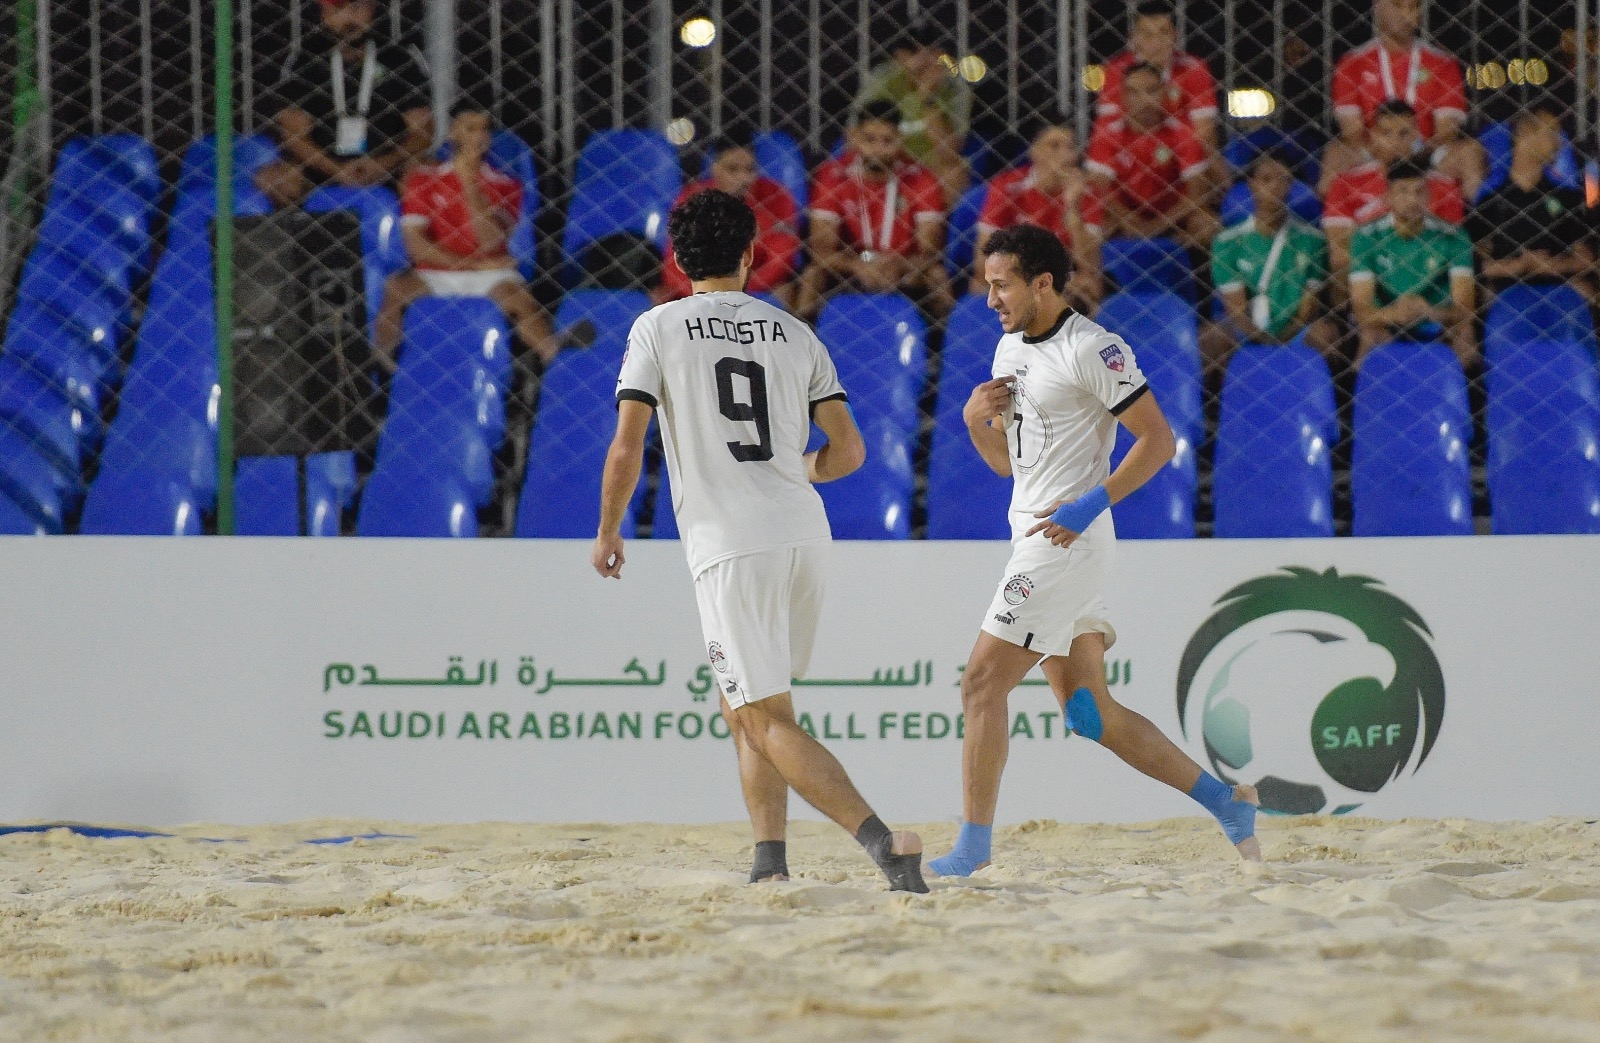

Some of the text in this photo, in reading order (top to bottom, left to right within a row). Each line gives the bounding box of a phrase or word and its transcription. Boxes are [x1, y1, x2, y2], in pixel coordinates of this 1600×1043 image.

[685, 317, 788, 345] H.COSTA
[714, 356, 774, 462] 9
[1013, 412, 1024, 458] 7
[994, 613, 1012, 625] PUMA
[322, 655, 500, 693] القدم
[324, 710, 447, 740] SAUDI
[458, 710, 643, 740] ARABIAN
[654, 710, 866, 740] FOOALL
[1321, 723, 1402, 749] SAFF
